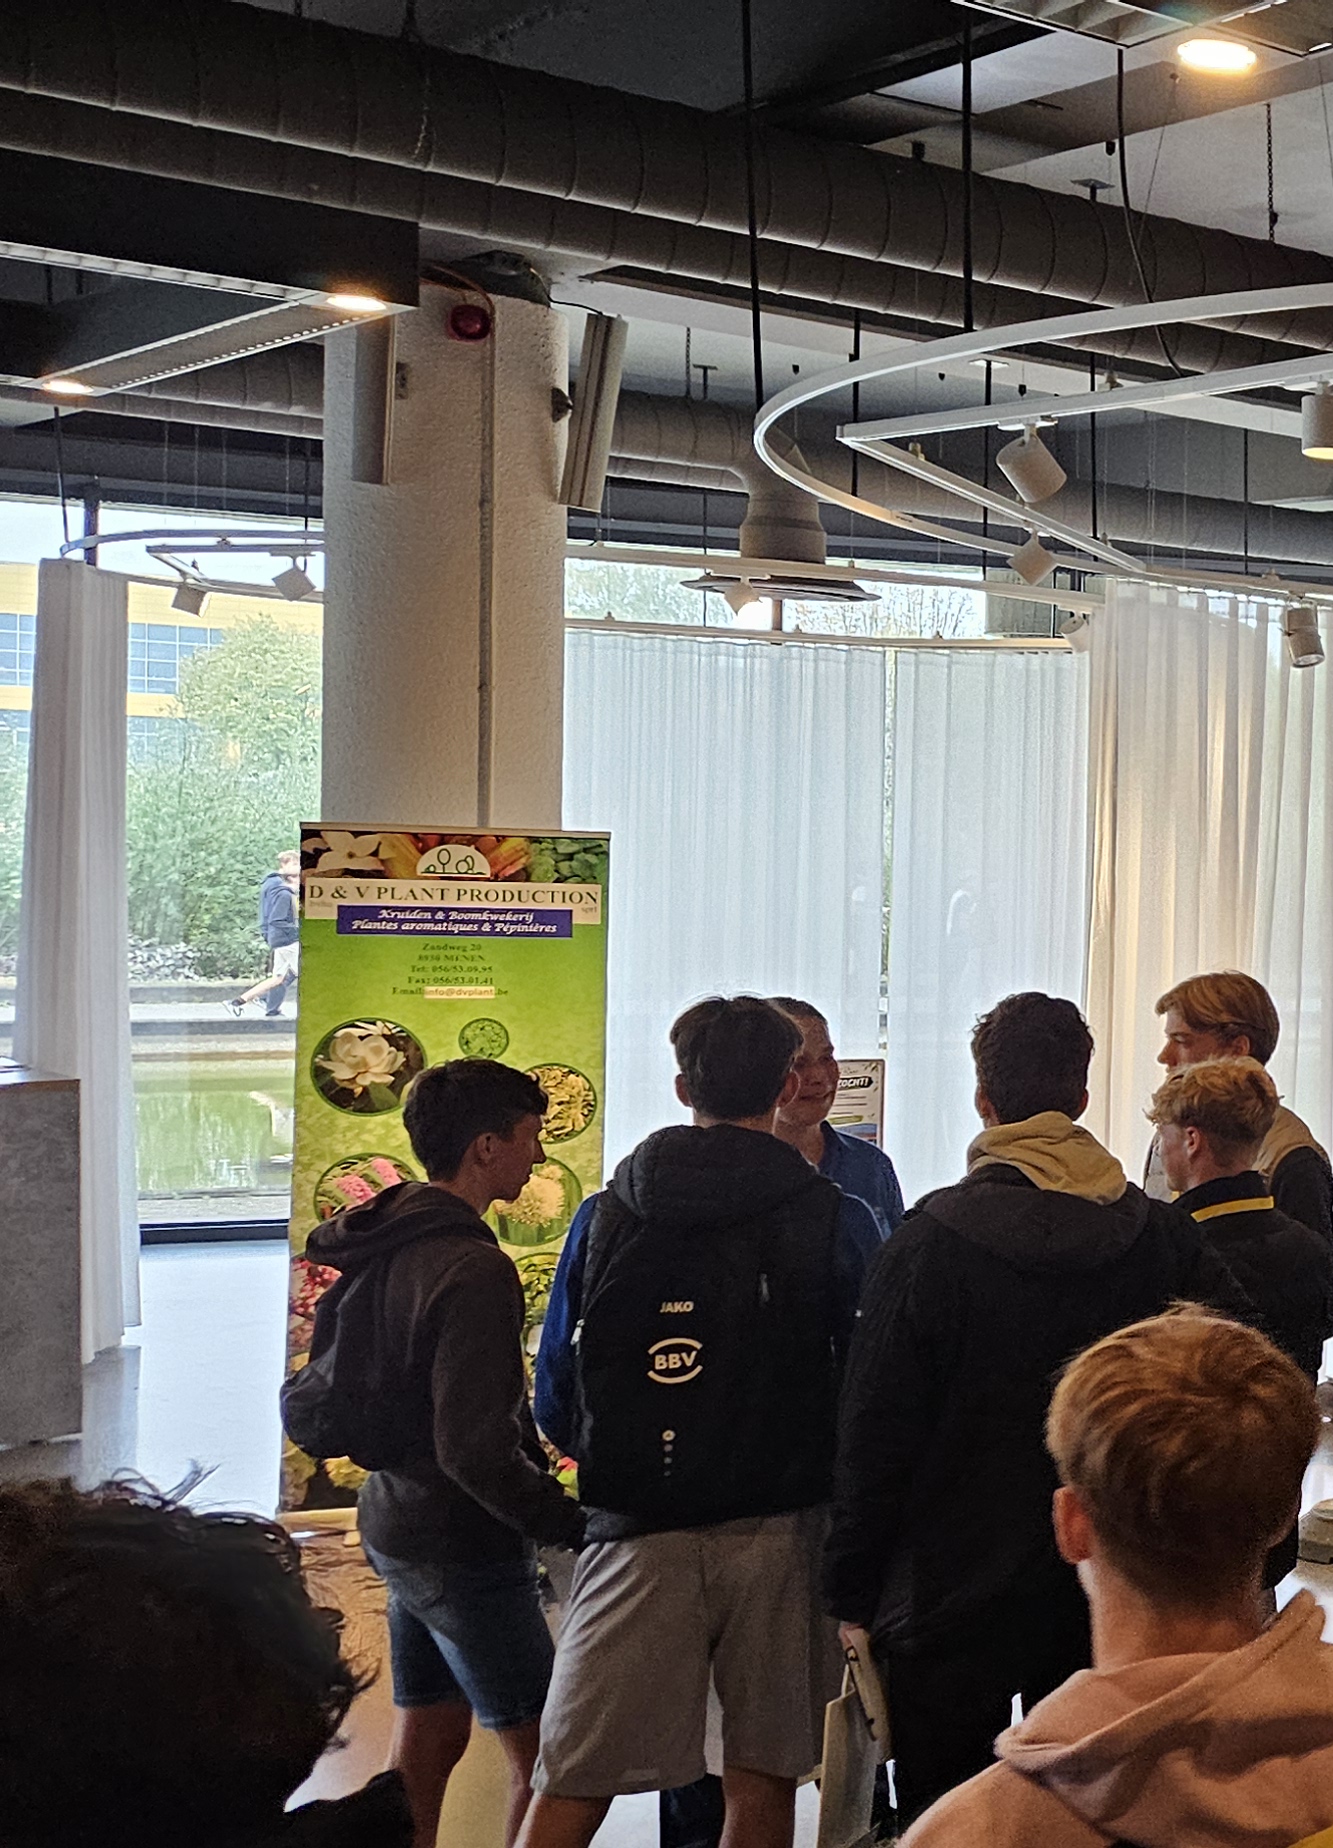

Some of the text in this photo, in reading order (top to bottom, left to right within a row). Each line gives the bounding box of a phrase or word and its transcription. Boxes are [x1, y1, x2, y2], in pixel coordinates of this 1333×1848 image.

[309, 885, 598, 905] D & V PLANT PRODUCTION
[378, 909, 534, 923] Kruiden & Boomkwekerij
[352, 919, 557, 935] Plantes aromatiques & Pépinières
[660, 1301, 694, 1313] JAKO
[655, 1351, 697, 1370] BBV
